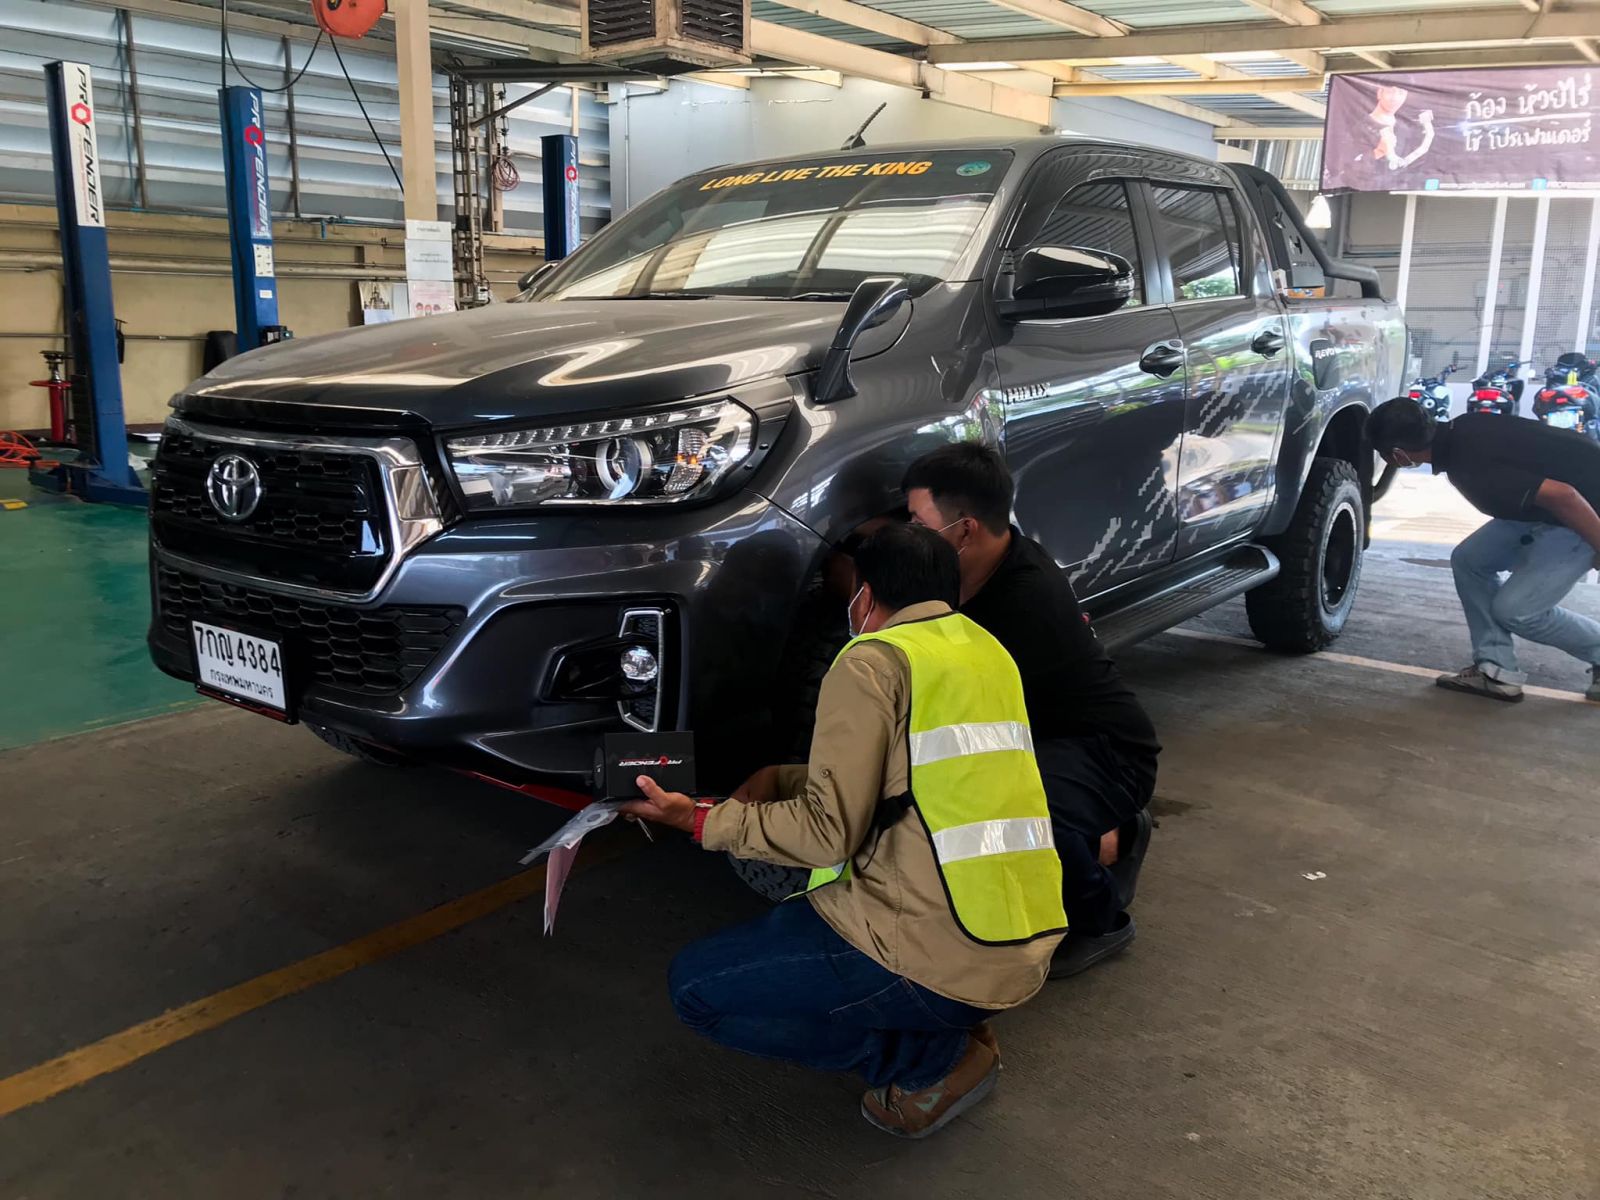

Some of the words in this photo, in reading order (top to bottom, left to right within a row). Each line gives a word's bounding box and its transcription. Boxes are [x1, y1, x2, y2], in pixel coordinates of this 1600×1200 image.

[71, 66, 100, 224] PROFENDER
[244, 91, 270, 237] PROFENDER
[699, 171, 762, 192] LONG
[760, 166, 820, 184] LIVE
[815, 161, 869, 178] THE
[862, 160, 933, 176] KING
[236, 638, 281, 678] 4384
